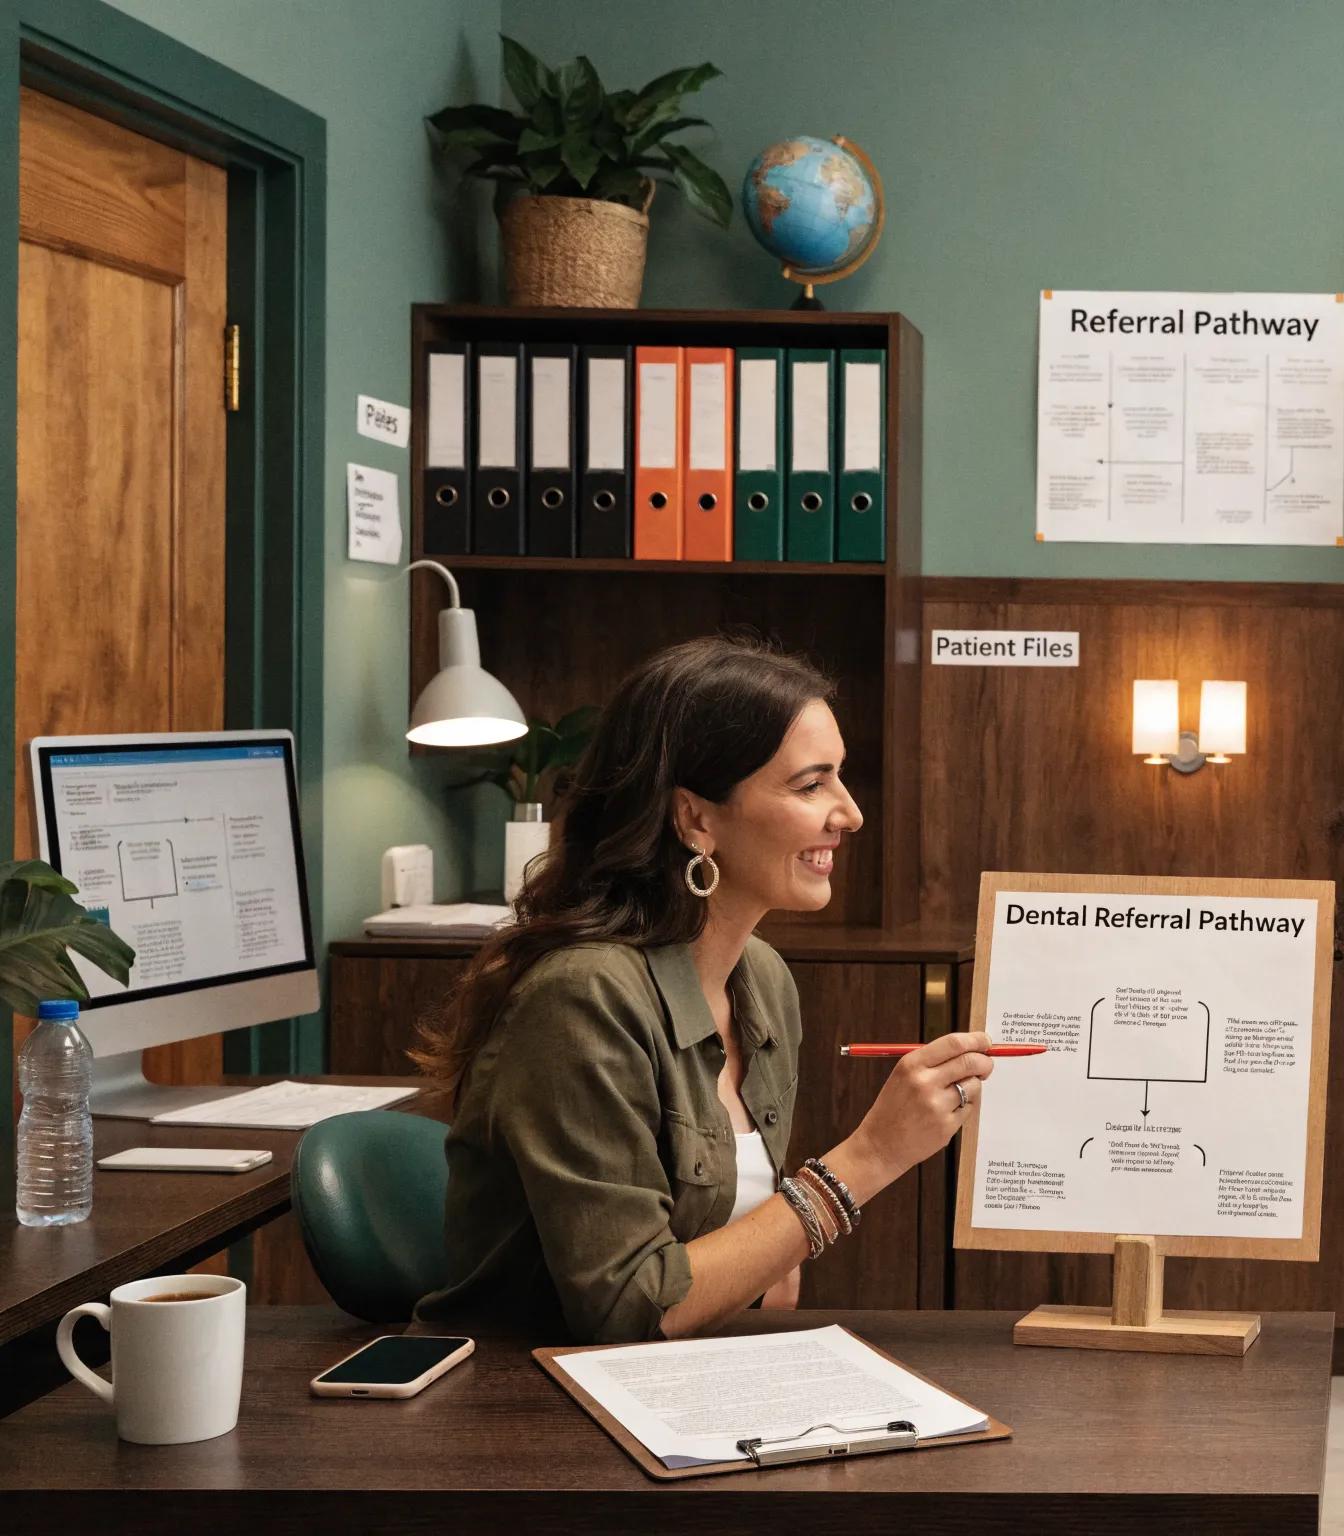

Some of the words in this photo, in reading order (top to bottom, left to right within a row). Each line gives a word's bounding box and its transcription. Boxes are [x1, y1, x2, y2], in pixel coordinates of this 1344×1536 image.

[1070, 308, 1184, 334] Referral
[1194, 310, 1320, 342] Pathway
[936, 636, 1017, 657] Patient
[1023, 637, 1073, 658] Files
[1006, 903, 1087, 927] Dental
[1094, 906, 1191, 930] Referral
[1198, 909, 1306, 938] Pathway
